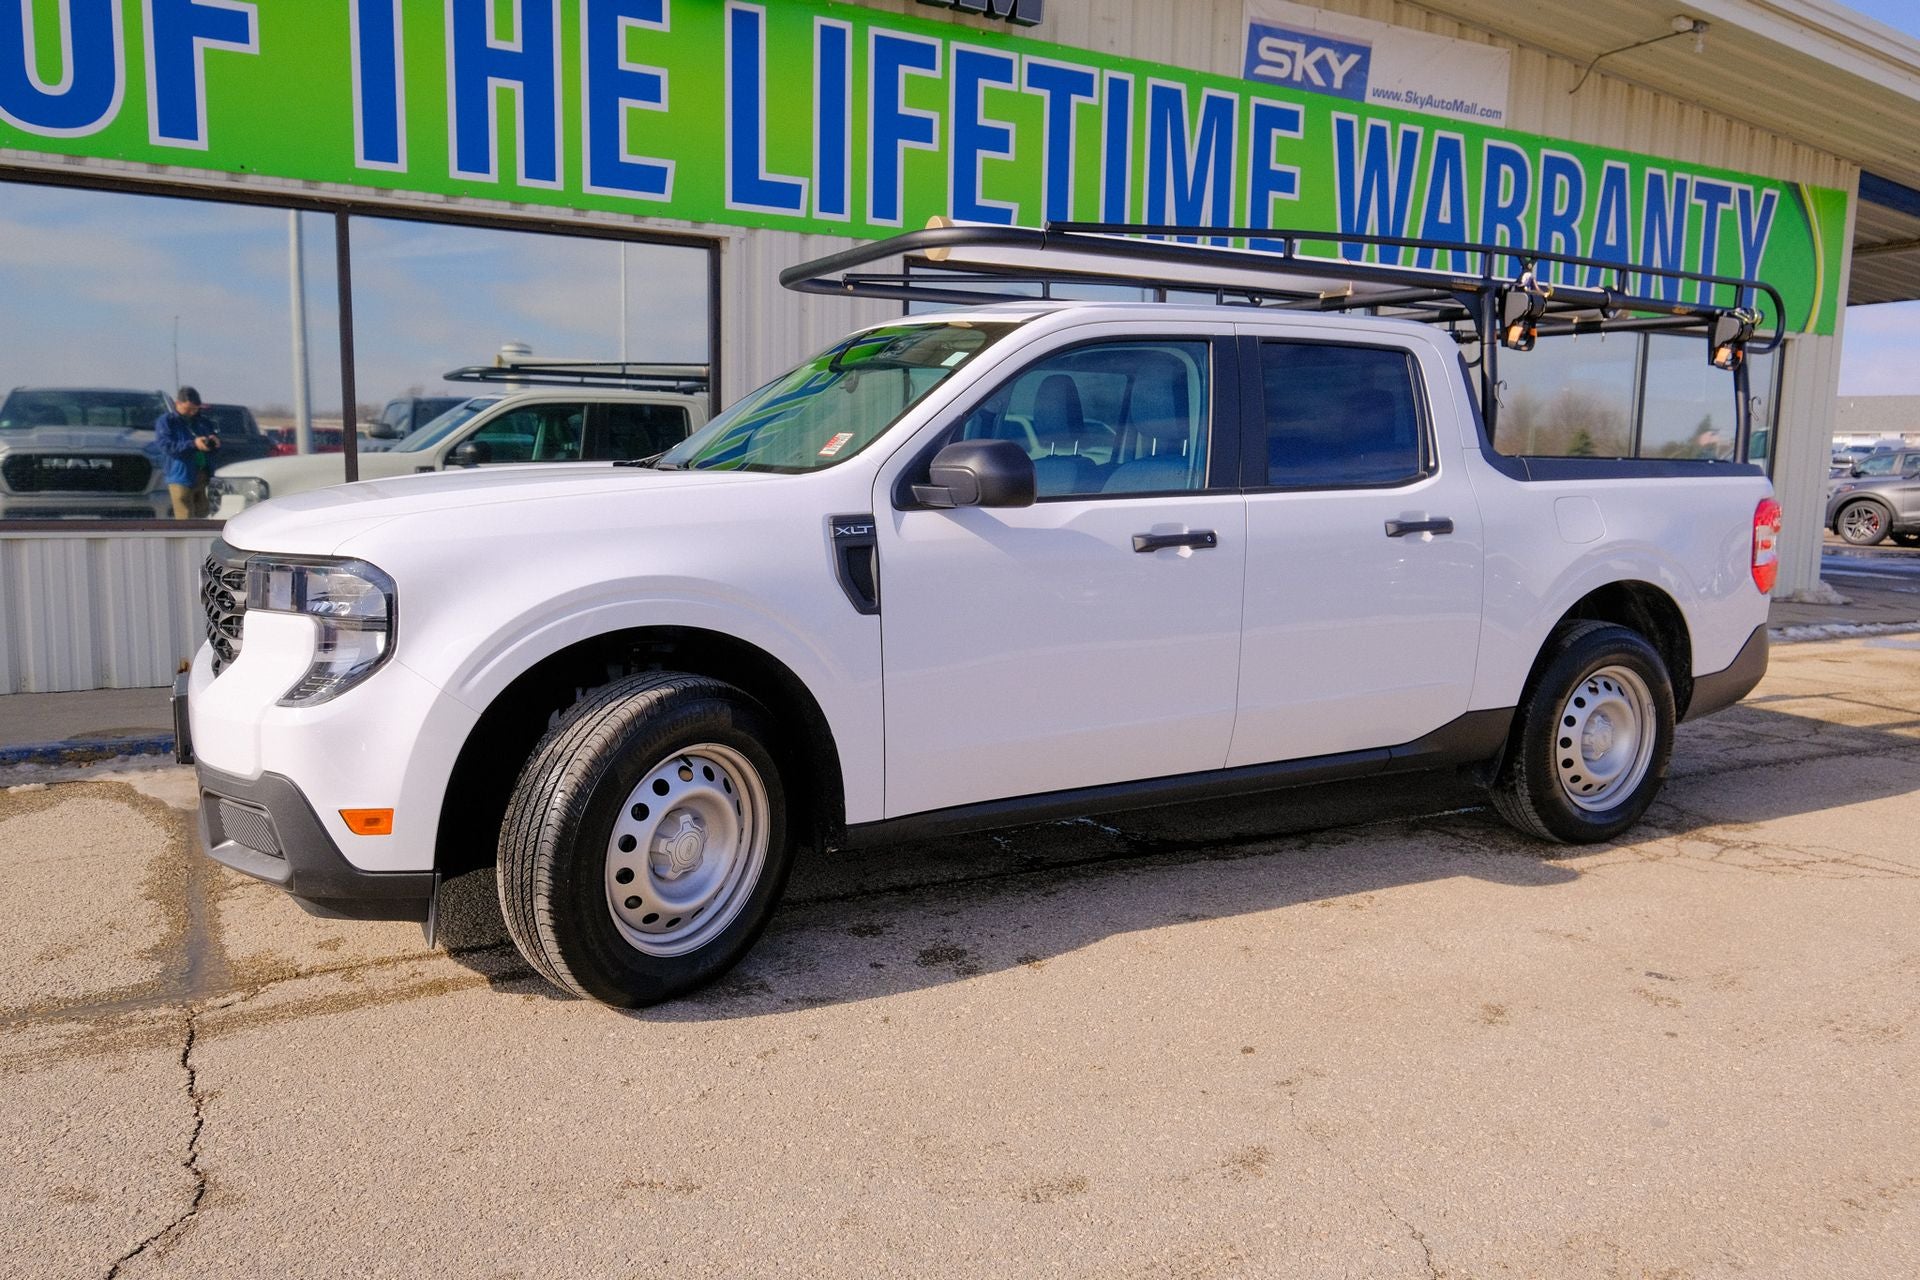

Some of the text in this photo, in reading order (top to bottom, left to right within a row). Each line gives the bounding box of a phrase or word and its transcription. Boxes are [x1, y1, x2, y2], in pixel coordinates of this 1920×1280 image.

[1253, 36, 1362, 90] SKY
[1372, 87, 1503, 121] www.SkyAutoMall.com
[724, 0, 1305, 257] LIFETIME
[1332, 111, 1780, 309] WARRANTY
[835, 525, 874, 536] XLT
